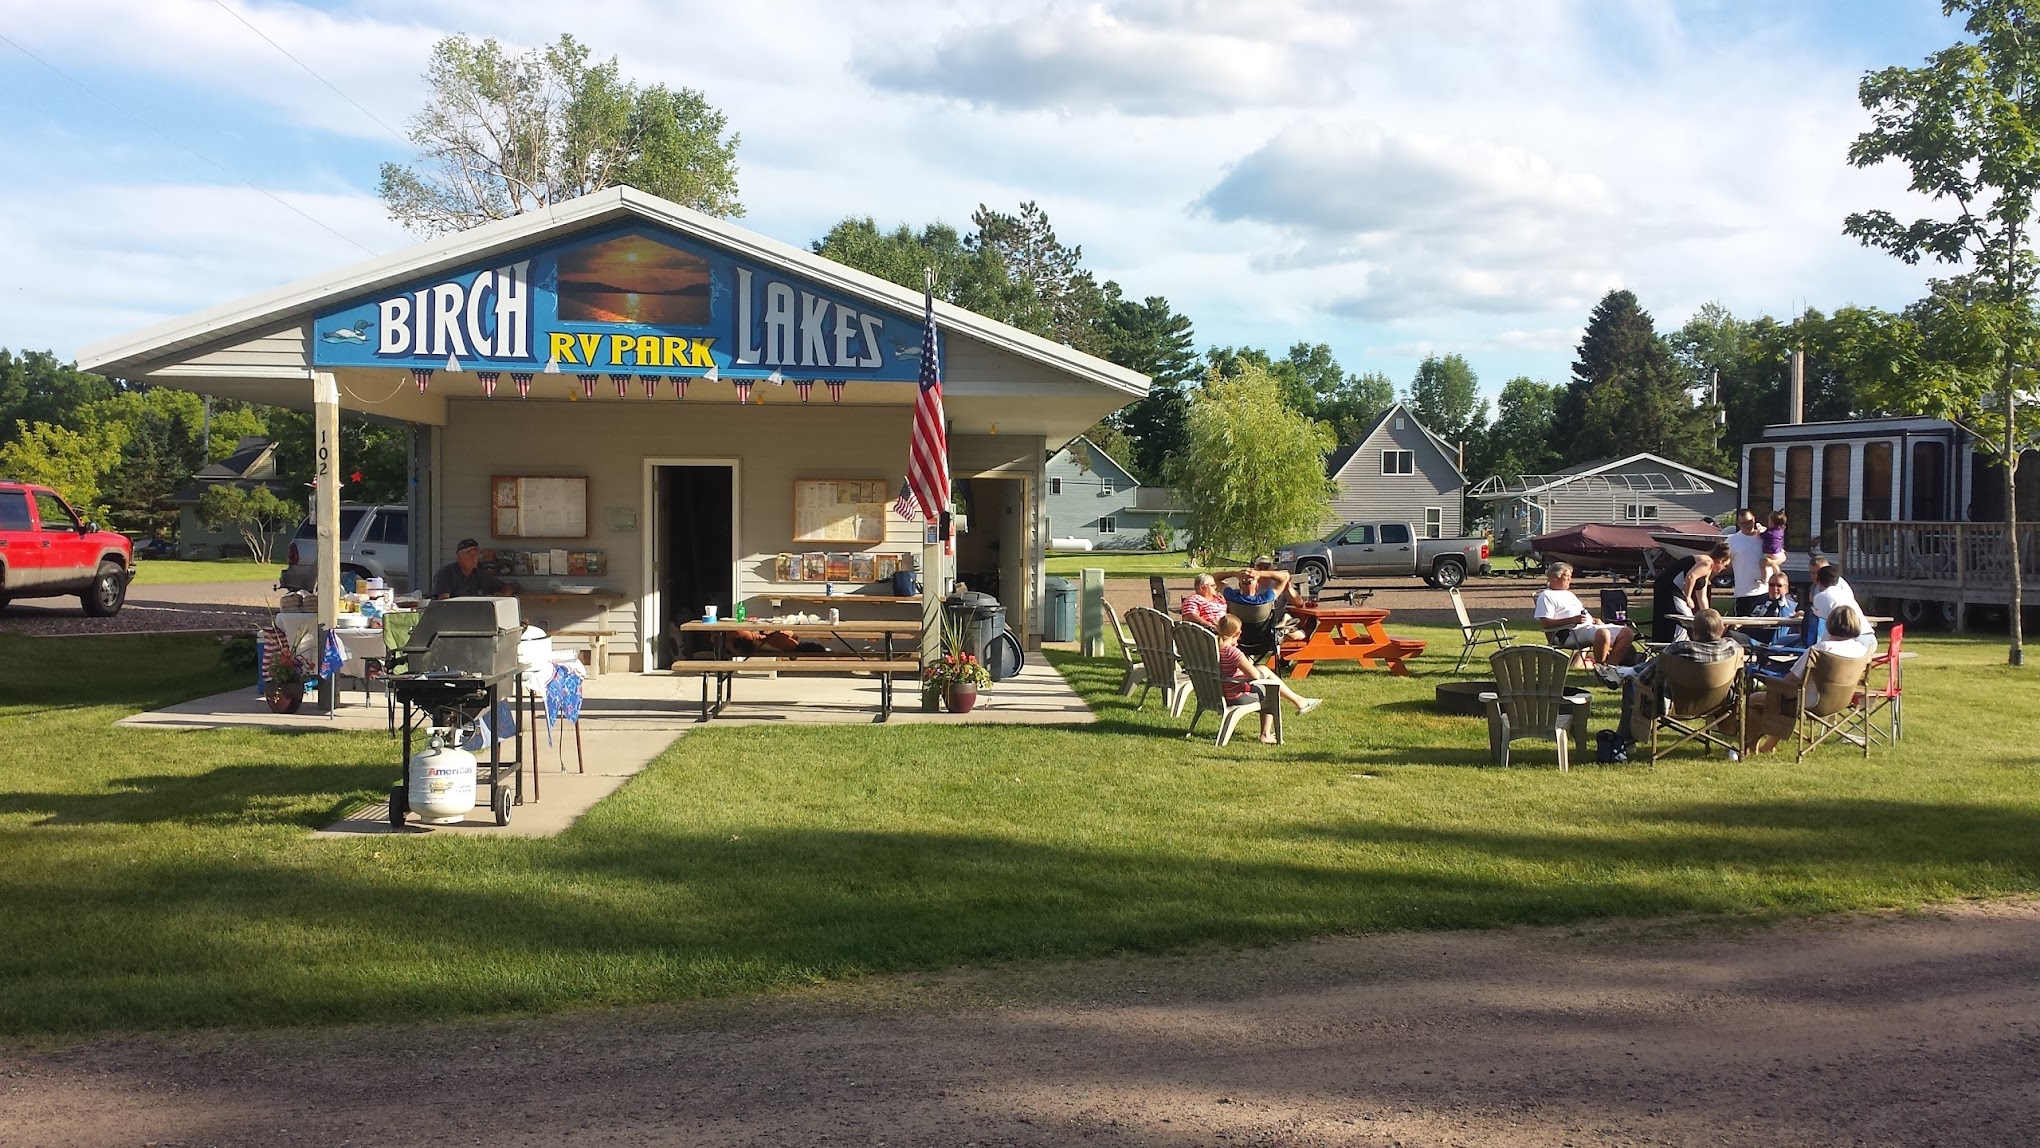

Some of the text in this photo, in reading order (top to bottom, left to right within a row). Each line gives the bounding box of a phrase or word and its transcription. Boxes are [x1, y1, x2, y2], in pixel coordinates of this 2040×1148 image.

[378, 260, 883, 368] BIRCH LAKES
[550, 333, 716, 368] RV PARK
[319, 430, 328, 475] 102
[429, 767, 472, 776] AmeriGas
